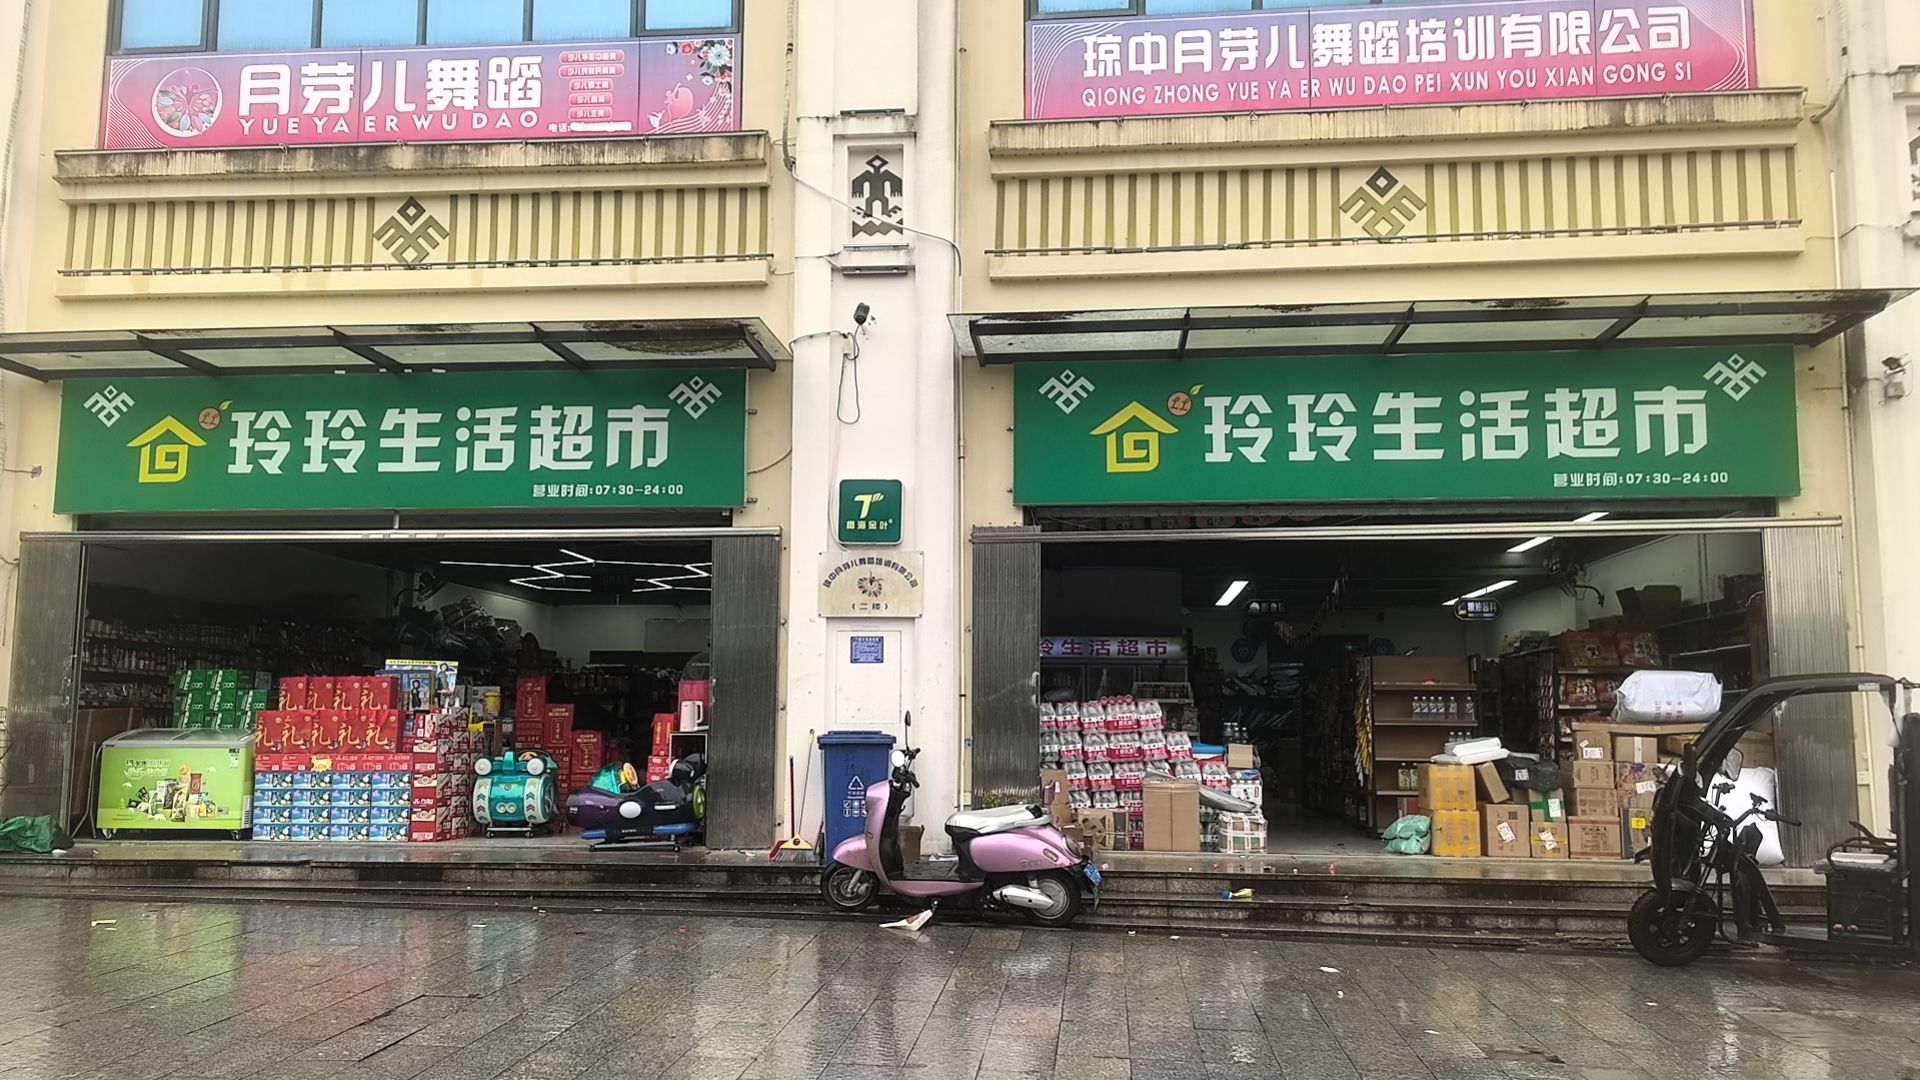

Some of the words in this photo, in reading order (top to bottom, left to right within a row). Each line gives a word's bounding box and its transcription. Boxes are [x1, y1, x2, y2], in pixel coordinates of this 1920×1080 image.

[1082, 6, 1691, 78] 琼中月芽儿舞蹈培训有限公司
[238, 56, 543, 116] 月芽儿舞蹈
[1082, 87, 1146, 107] QIONG
[1154, 83, 1219, 104] ZHONG
[1227, 81, 1259, 100] YUE
[1267, 80, 1292, 99] YA
[1300, 79, 1321, 98] ER
[1328, 77, 1356, 96] WU
[1364, 74, 1407, 95] DAO
[1415, 73, 1442, 92] PEI
[1450, 70, 1489, 91] XUN
[1497, 68, 1536, 89] YOU
[1545, 66, 1594, 87] XIAN
[1602, 62, 1667, 84] GONG
[1675, 61, 1691, 81] SI
[240, 117, 299, 135] YUE
[312, 116, 350, 133] YA
[364, 115, 400, 132] ER
[412, 113, 457, 131] WU
[472, 110, 538, 129] DAO
[227, 405, 671, 475] 玲玲生活超市
[1204, 385, 1708, 464] 玲玲生活超市
